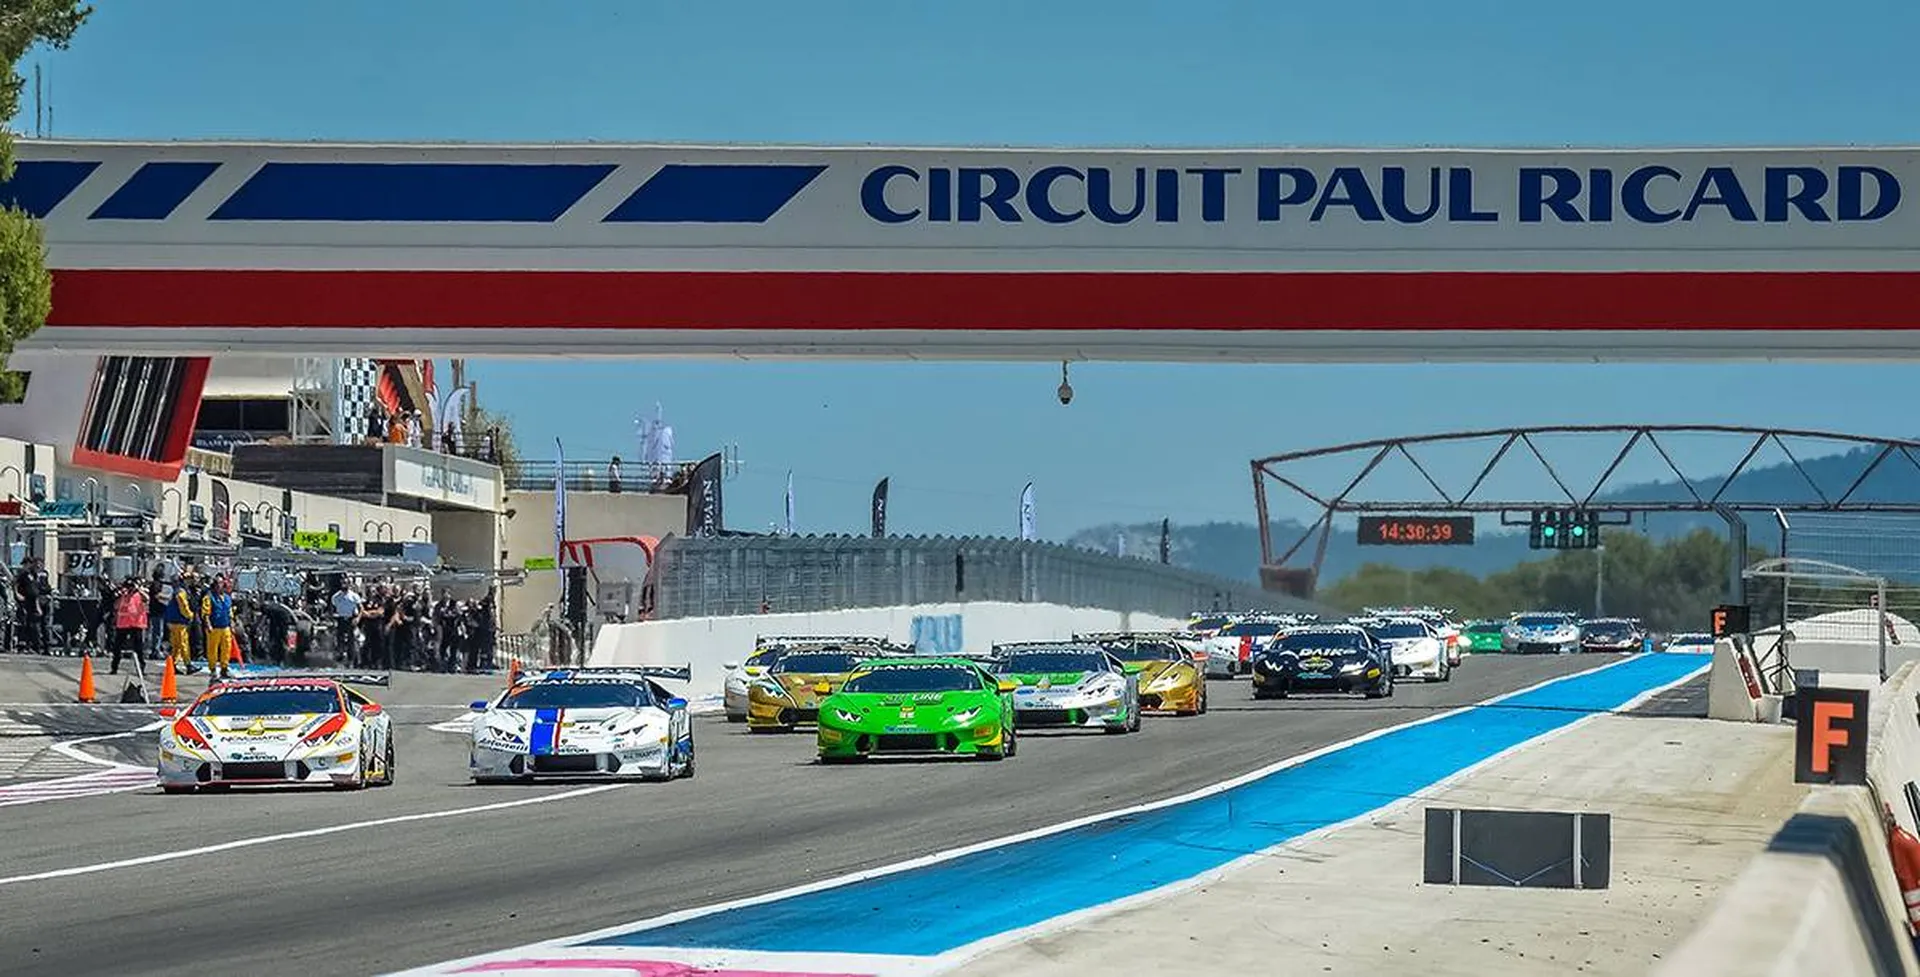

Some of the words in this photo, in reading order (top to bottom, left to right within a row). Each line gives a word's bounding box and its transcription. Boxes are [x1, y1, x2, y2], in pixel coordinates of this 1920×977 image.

[861, 167, 1241, 224] CIRCUIT
[1258, 168, 1498, 223] PAUL
[1519, 167, 1901, 224] RICARD
[1380, 523, 1452, 540] 14:30:39
[69, 553, 95, 568] 98
[1714, 611, 1727, 635] F
[213, 685, 329, 693] BLANCPAIN
[1812, 702, 1854, 773] F
